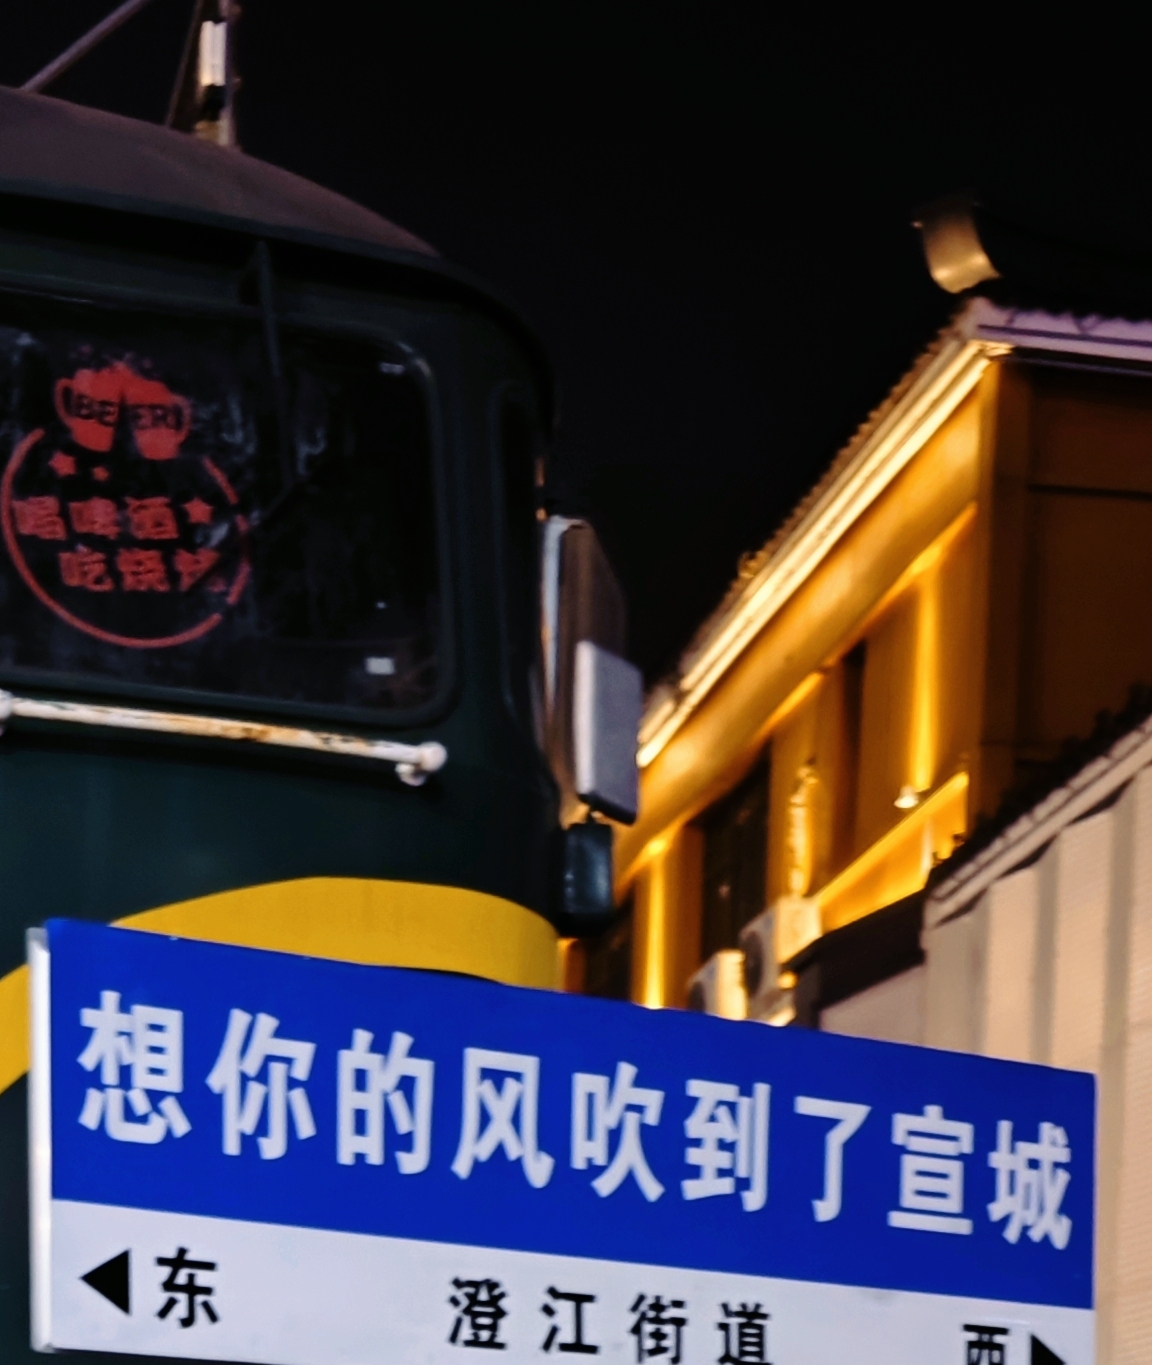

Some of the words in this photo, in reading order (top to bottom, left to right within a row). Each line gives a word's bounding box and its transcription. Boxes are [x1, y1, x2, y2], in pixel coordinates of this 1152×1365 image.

[77, 990, 1073, 1251] 想你的风吹到了宣城
[155, 1247, 219, 1328] 东
